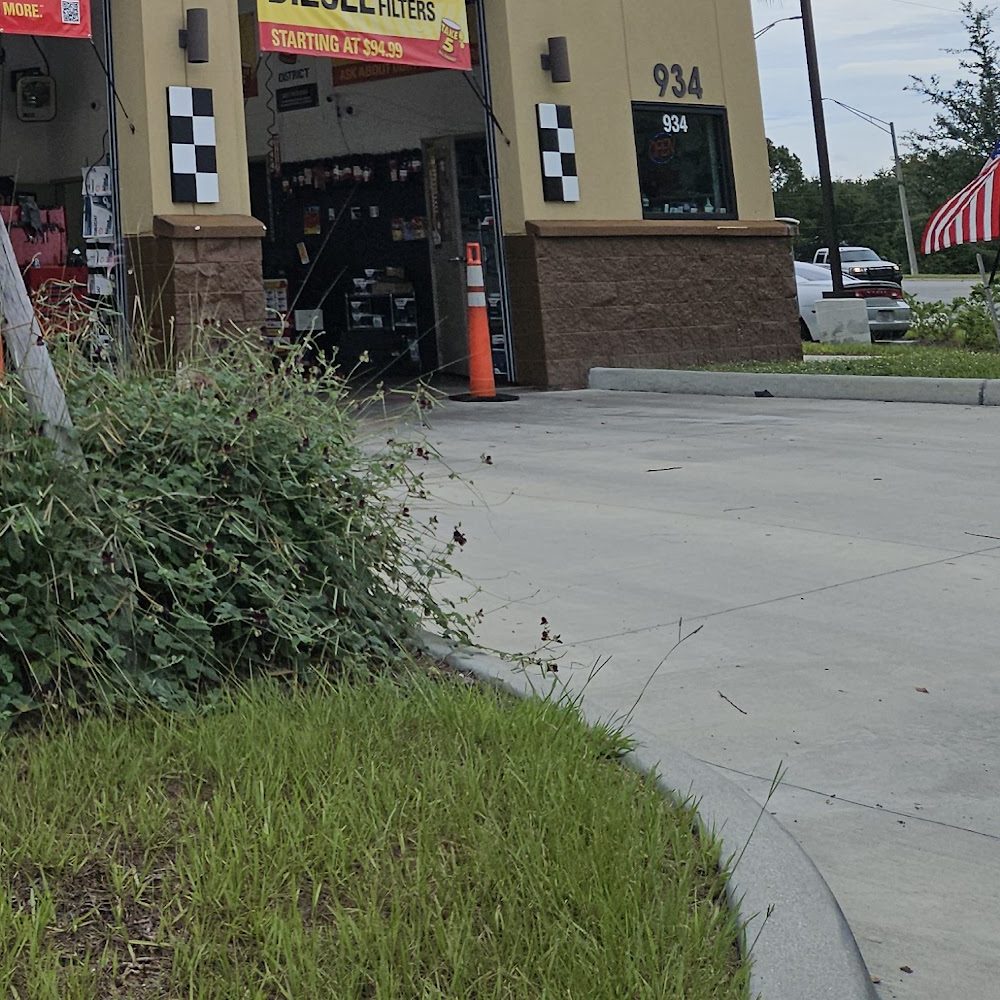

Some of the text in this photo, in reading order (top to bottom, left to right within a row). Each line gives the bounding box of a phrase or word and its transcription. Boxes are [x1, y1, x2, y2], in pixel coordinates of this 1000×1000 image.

[271, 28, 404, 60] STARTING AT $94.99
[442, 36, 455, 53] 5
[278, 67, 311, 83] DISTRICT
[653, 63, 704, 100] 934
[662, 114, 689, 134] 934
